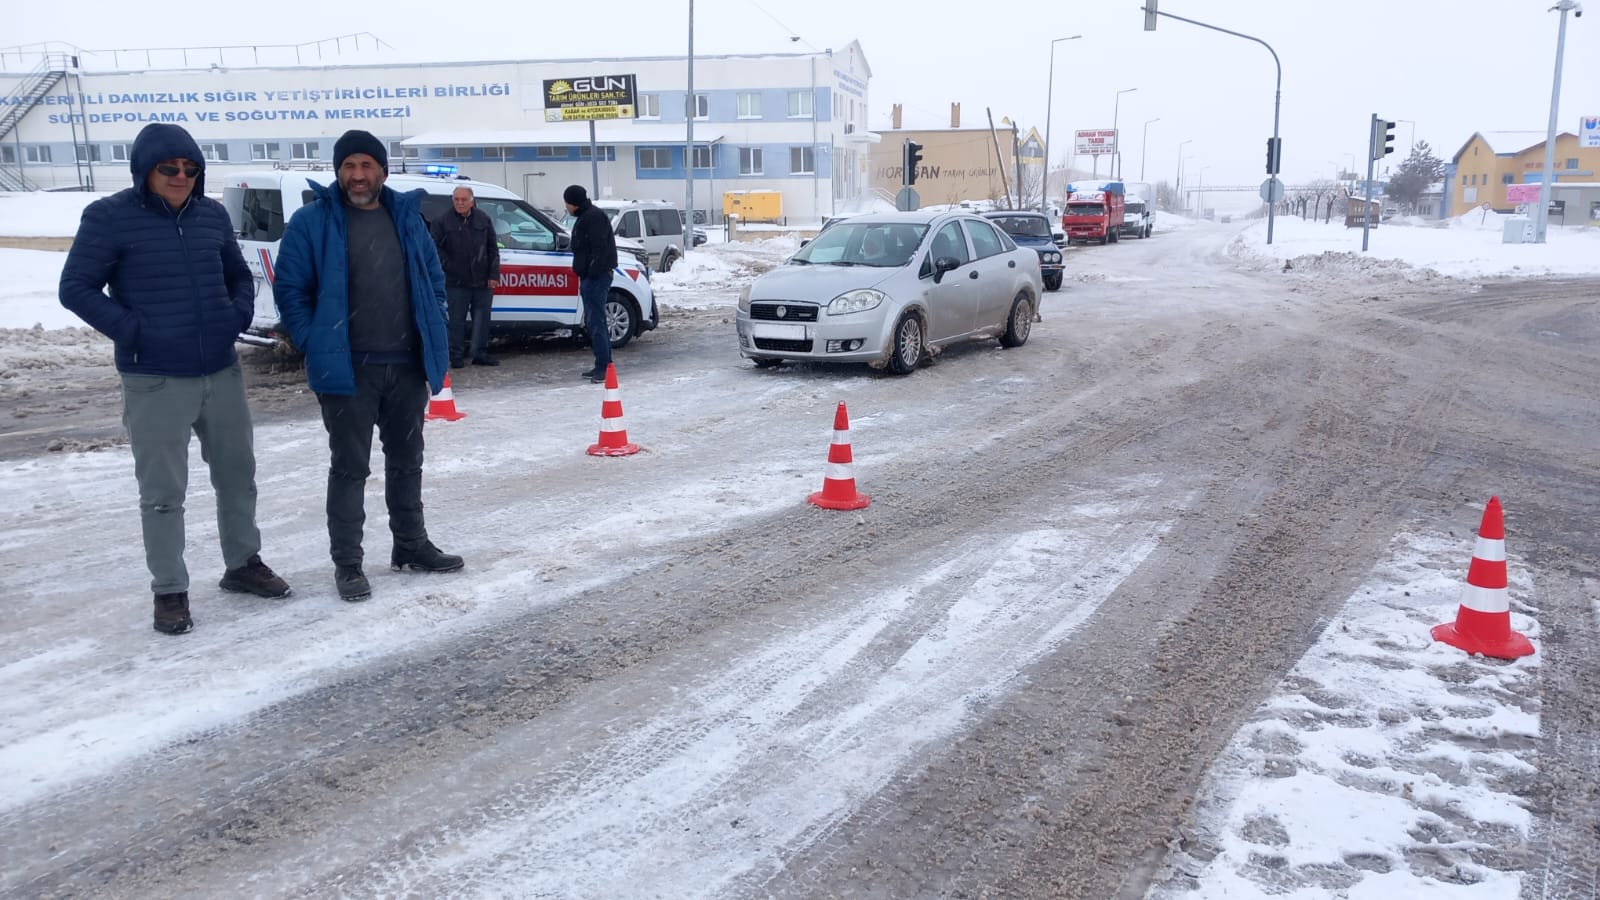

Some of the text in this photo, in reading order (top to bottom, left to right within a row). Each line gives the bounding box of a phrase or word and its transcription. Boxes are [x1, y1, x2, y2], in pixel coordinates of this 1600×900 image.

[573, 76, 626, 92] GÜN
[108, 92, 200, 104] DAMIZLIK
[204, 90, 256, 102] SIĞIR
[264, 85, 428, 102] YETİŞTİRİCİLERİ
[434, 83, 510, 97] BİRLİĞİ
[48, 105, 411, 124] SÜT DEPOLAMA VE SOĞUTMA MERKEZİ
[877, 166, 940, 179] HORSAN
[497, 273, 568, 288] NDARMASI
